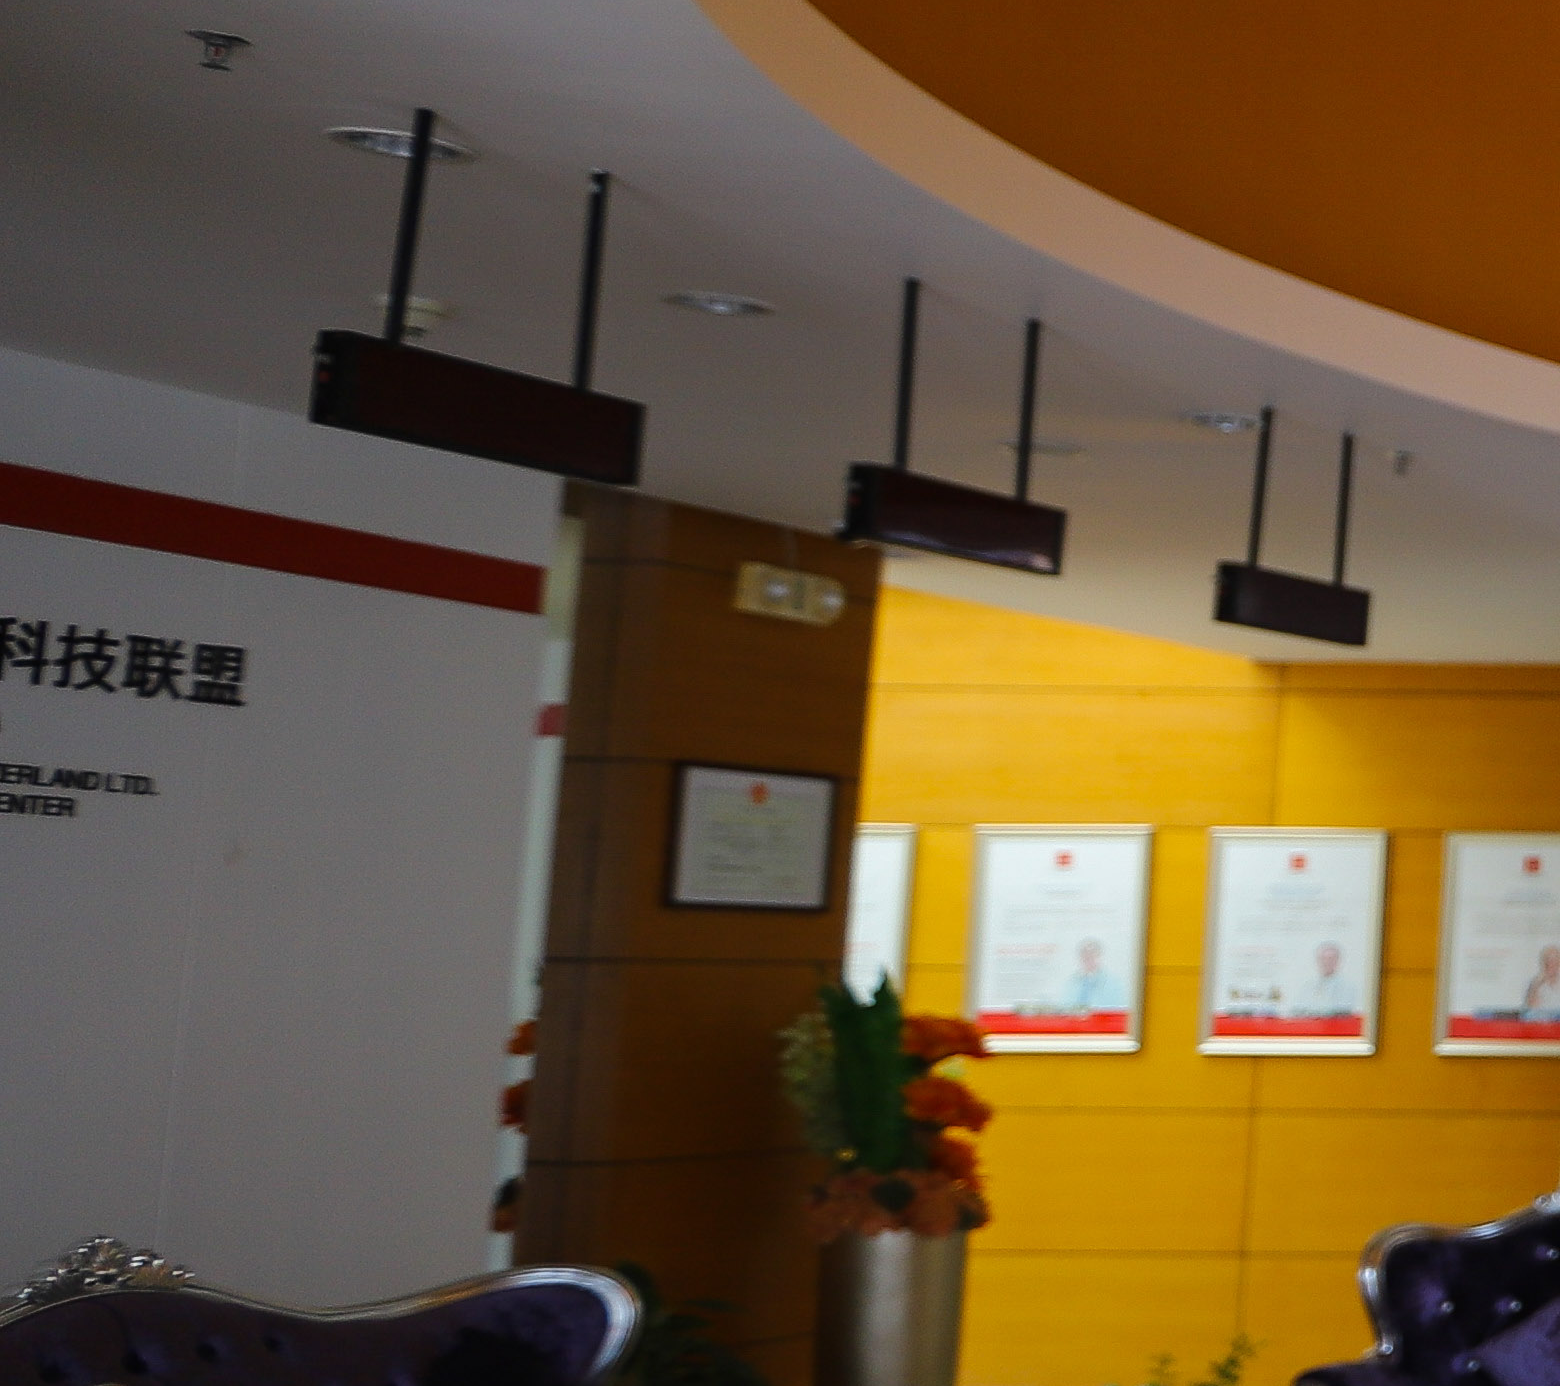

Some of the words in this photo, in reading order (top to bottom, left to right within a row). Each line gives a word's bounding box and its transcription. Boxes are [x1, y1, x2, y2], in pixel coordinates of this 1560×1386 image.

[0, 616, 246, 707] 科技联盟
[0, 762, 99, 791] ERLAND
